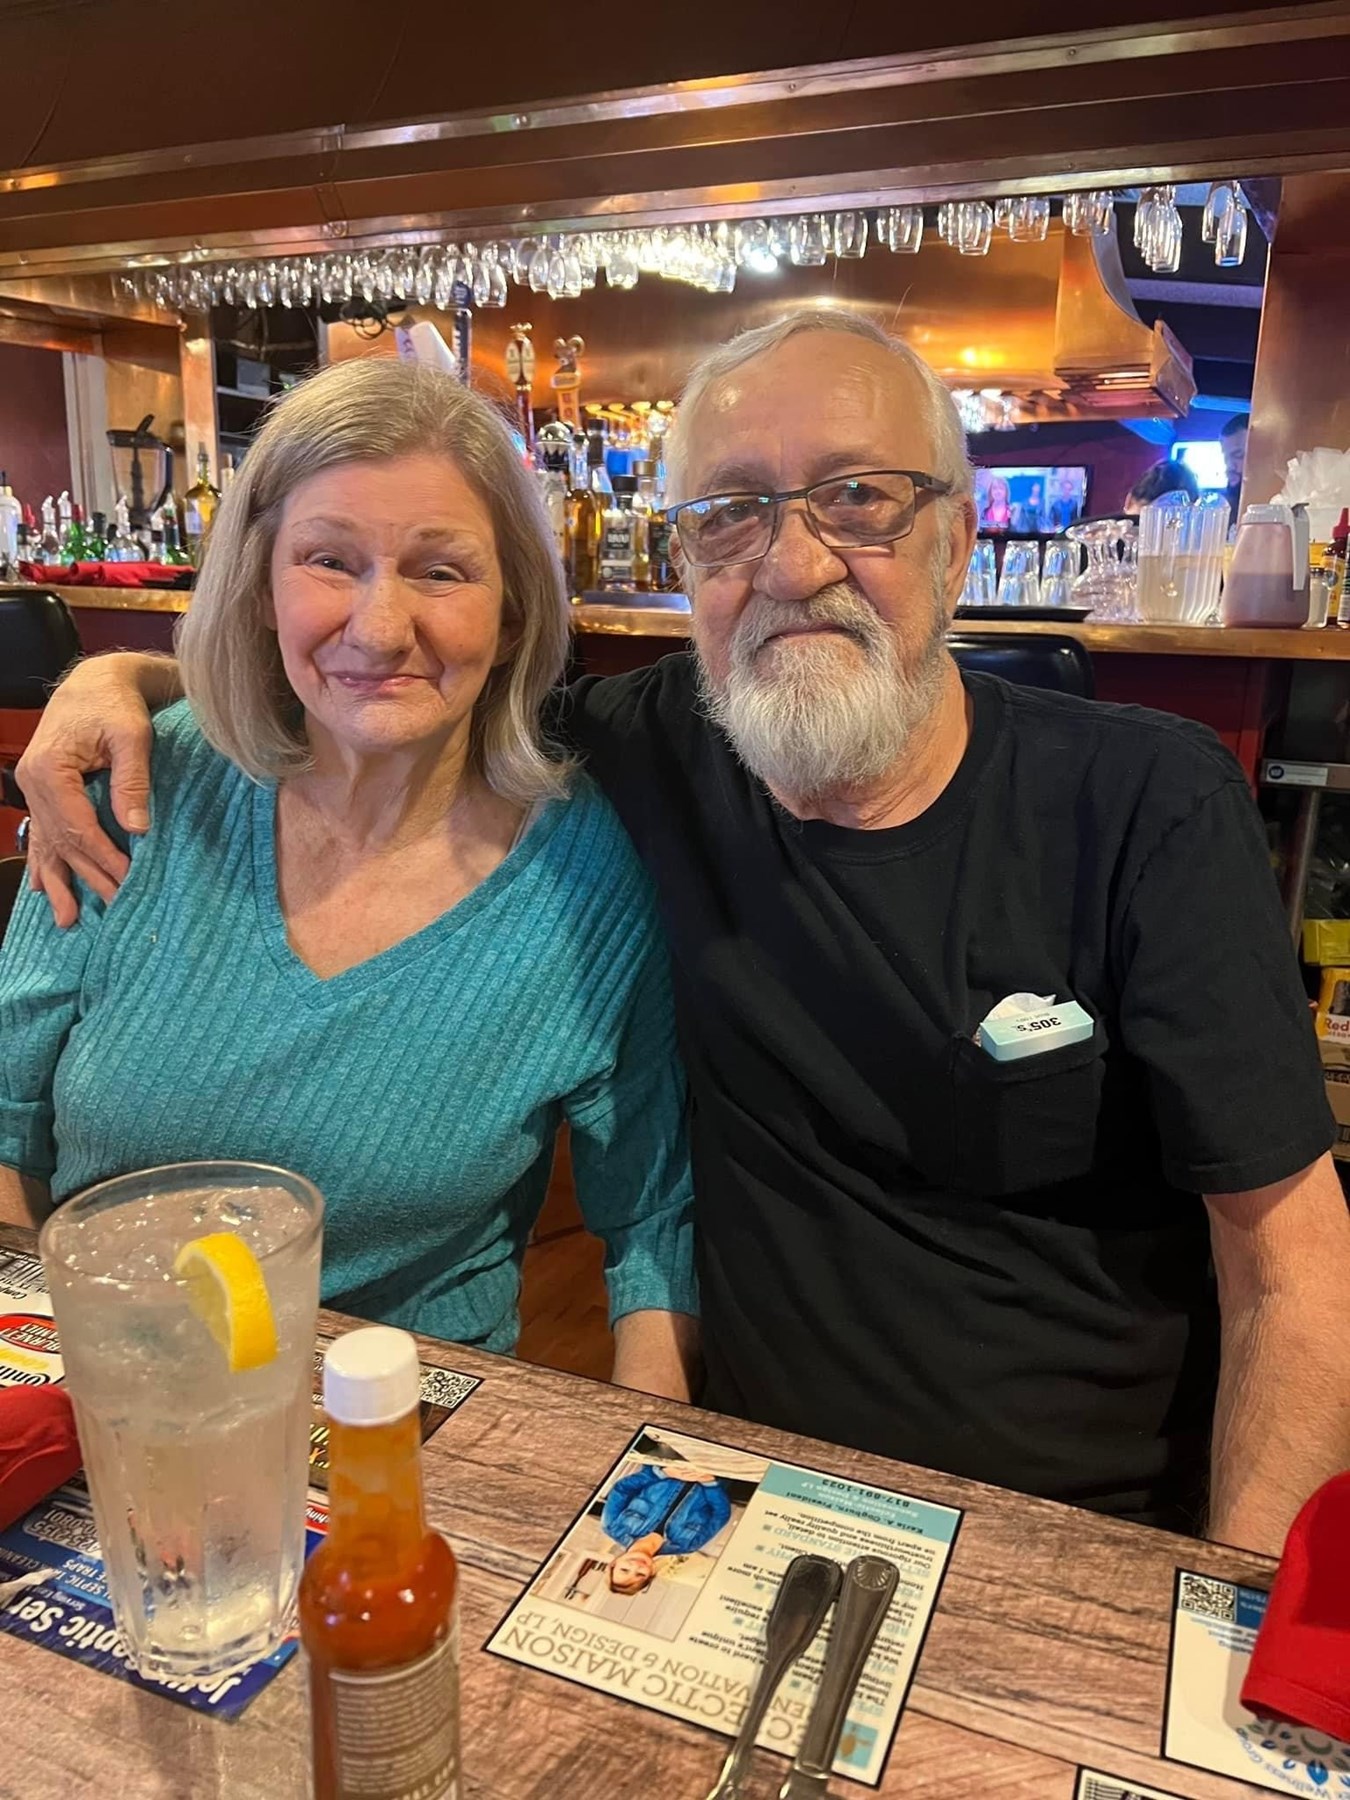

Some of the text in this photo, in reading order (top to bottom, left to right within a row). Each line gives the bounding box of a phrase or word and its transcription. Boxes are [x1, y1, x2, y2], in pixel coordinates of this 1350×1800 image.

[1017, 1018, 1062, 1032] 305's
[62, 1559, 98, 1579] TRAPS
[65, 1574, 105, 1595] SEPTIC
[512, 1608, 547, 1630] LP
[545, 1617, 641, 1661] DESIGN,
[498, 1625, 639, 1688] MAISON
[637, 1650, 660, 1669] &
